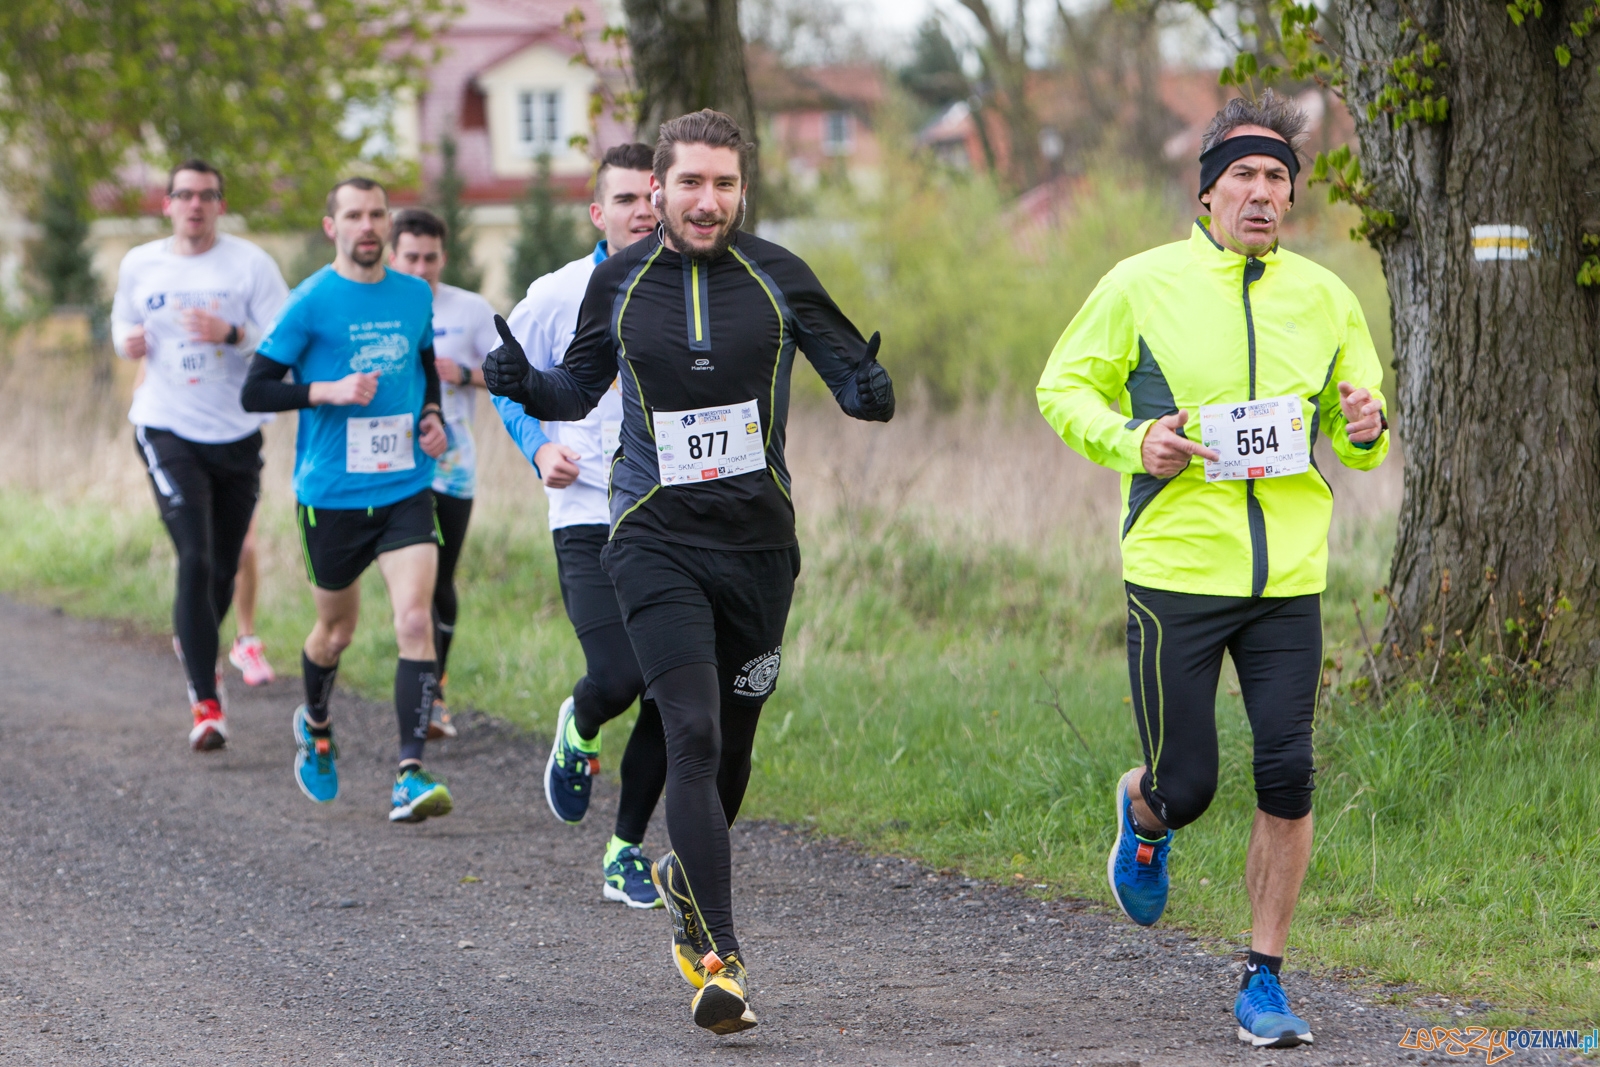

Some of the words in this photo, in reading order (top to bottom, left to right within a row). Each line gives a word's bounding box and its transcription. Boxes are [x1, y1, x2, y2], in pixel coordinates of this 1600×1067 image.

[371, 433, 398, 454] 507
[687, 430, 728, 460] 877
[1236, 426, 1279, 456] 554
[678, 463, 695, 471] 5KM
[727, 454, 747, 464] 10KM
[1275, 454, 1293, 462] 10KM
[741, 651, 772, 673] RUSSELL
[733, 675, 748, 688] 19
